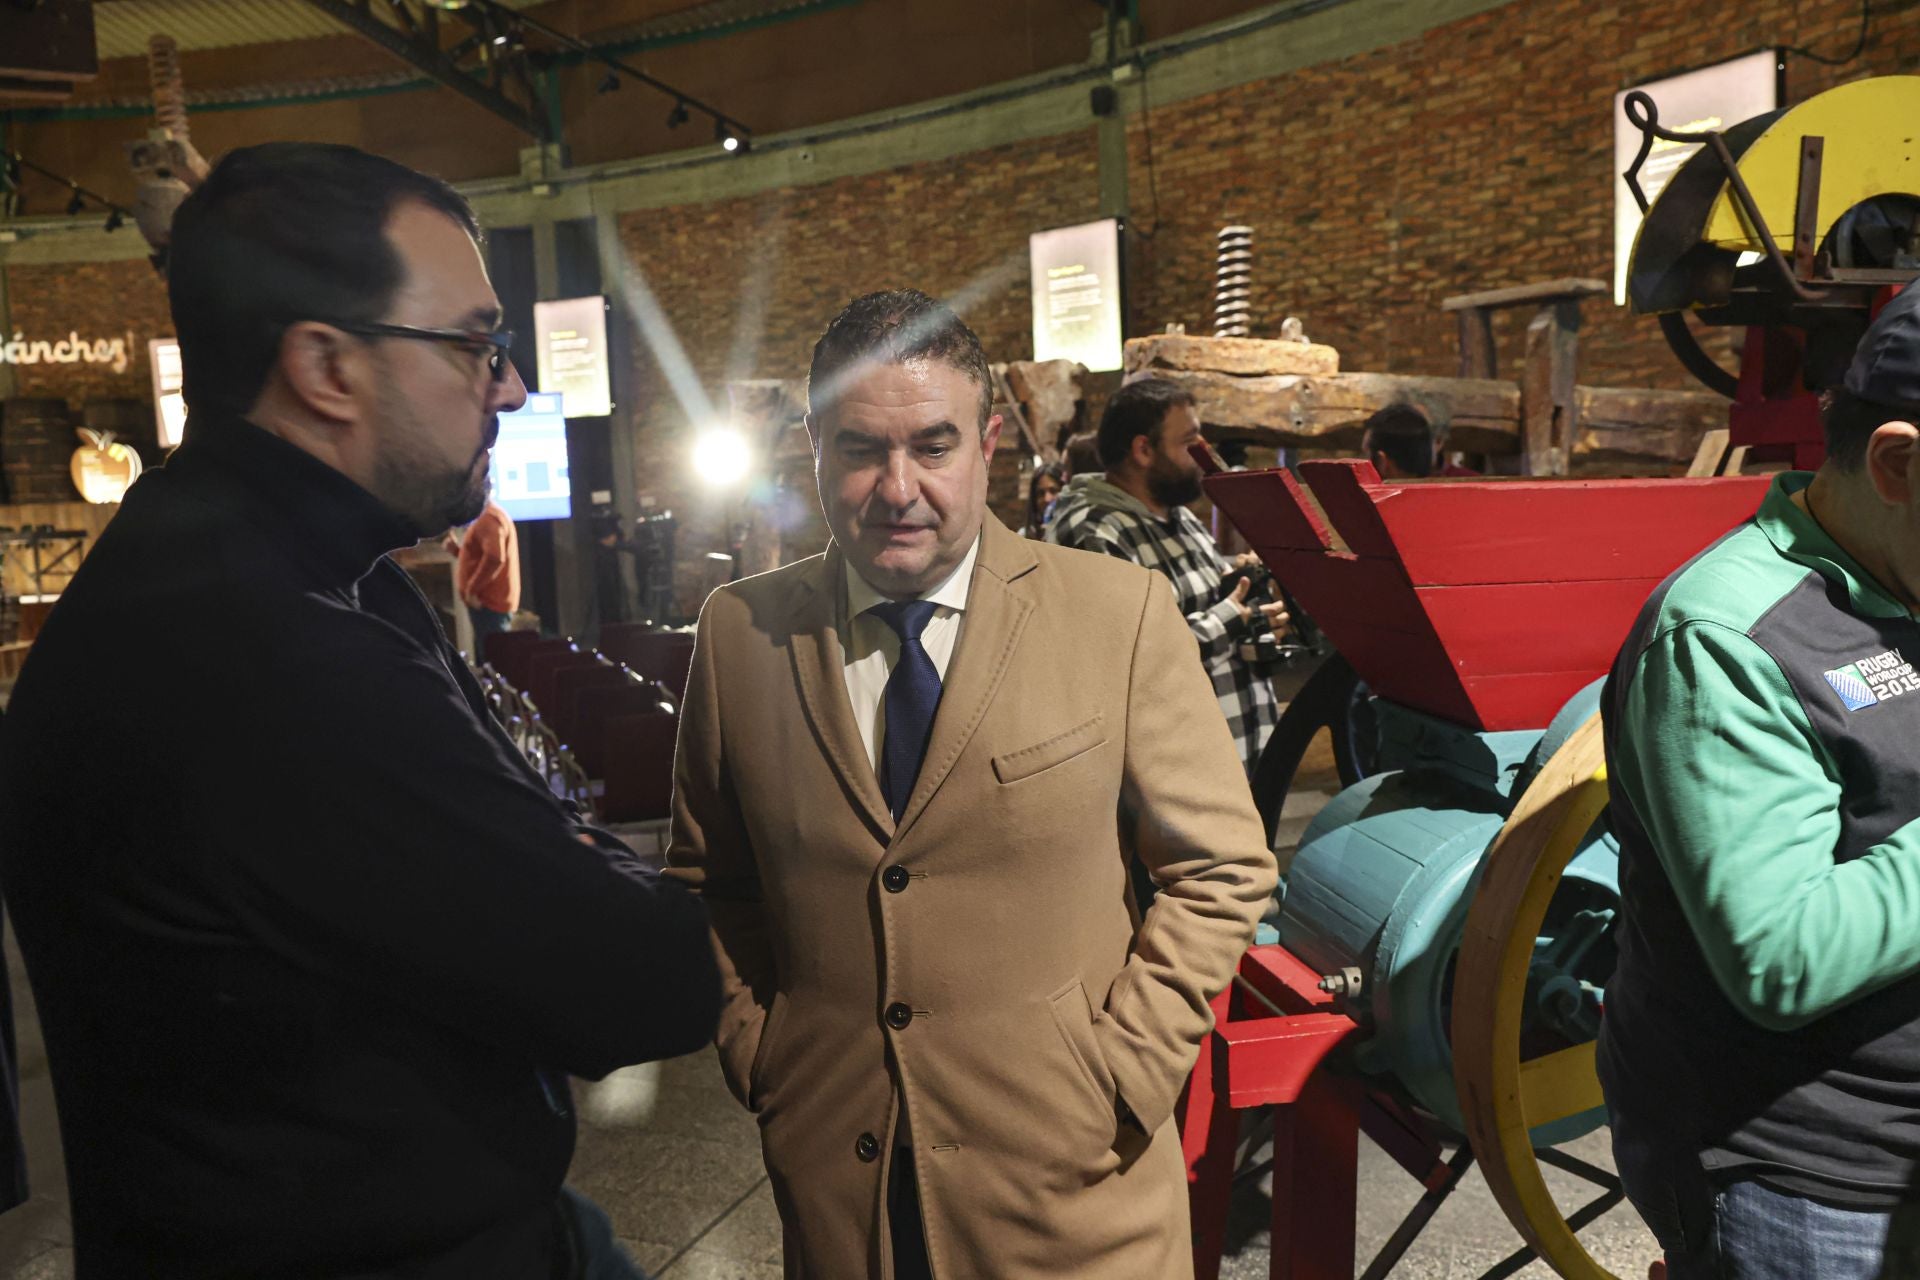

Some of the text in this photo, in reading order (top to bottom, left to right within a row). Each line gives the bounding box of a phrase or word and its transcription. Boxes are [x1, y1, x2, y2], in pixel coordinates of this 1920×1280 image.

[0, 330, 127, 374] ánchez
[1855, 648, 1905, 676] RUGBY
[1872, 672, 1920, 702] 2015
